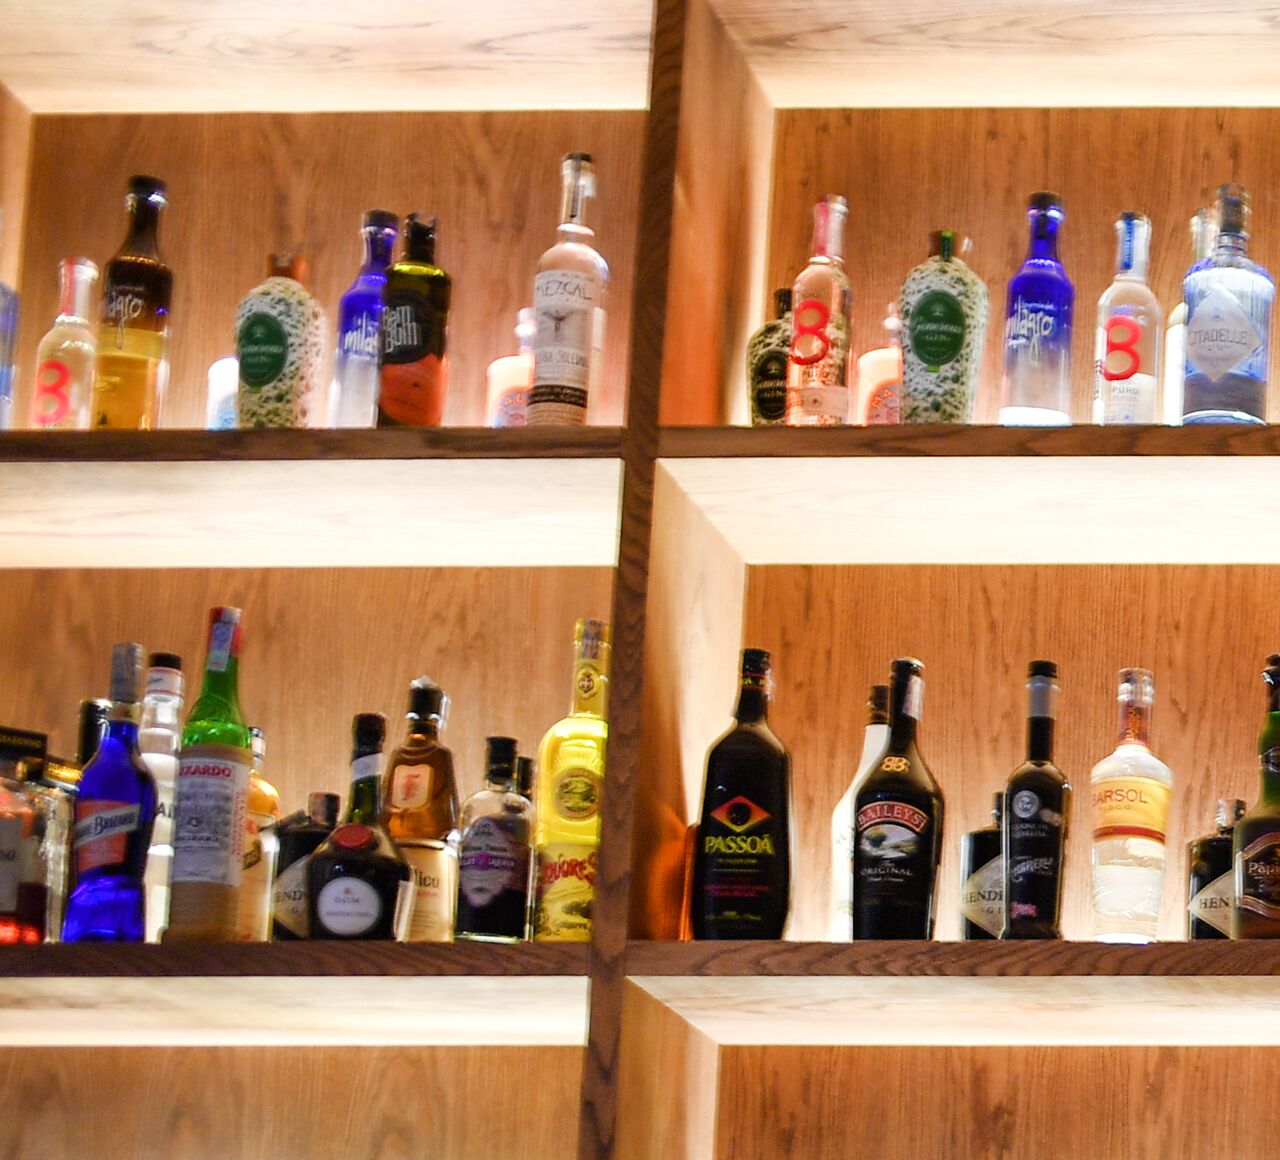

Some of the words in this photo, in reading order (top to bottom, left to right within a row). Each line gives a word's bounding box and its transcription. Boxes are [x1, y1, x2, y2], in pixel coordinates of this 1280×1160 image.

[788, 299, 829, 366] 8
[1099, 315, 1142, 381] 8
[856, 803, 926, 828] BAILEYS
